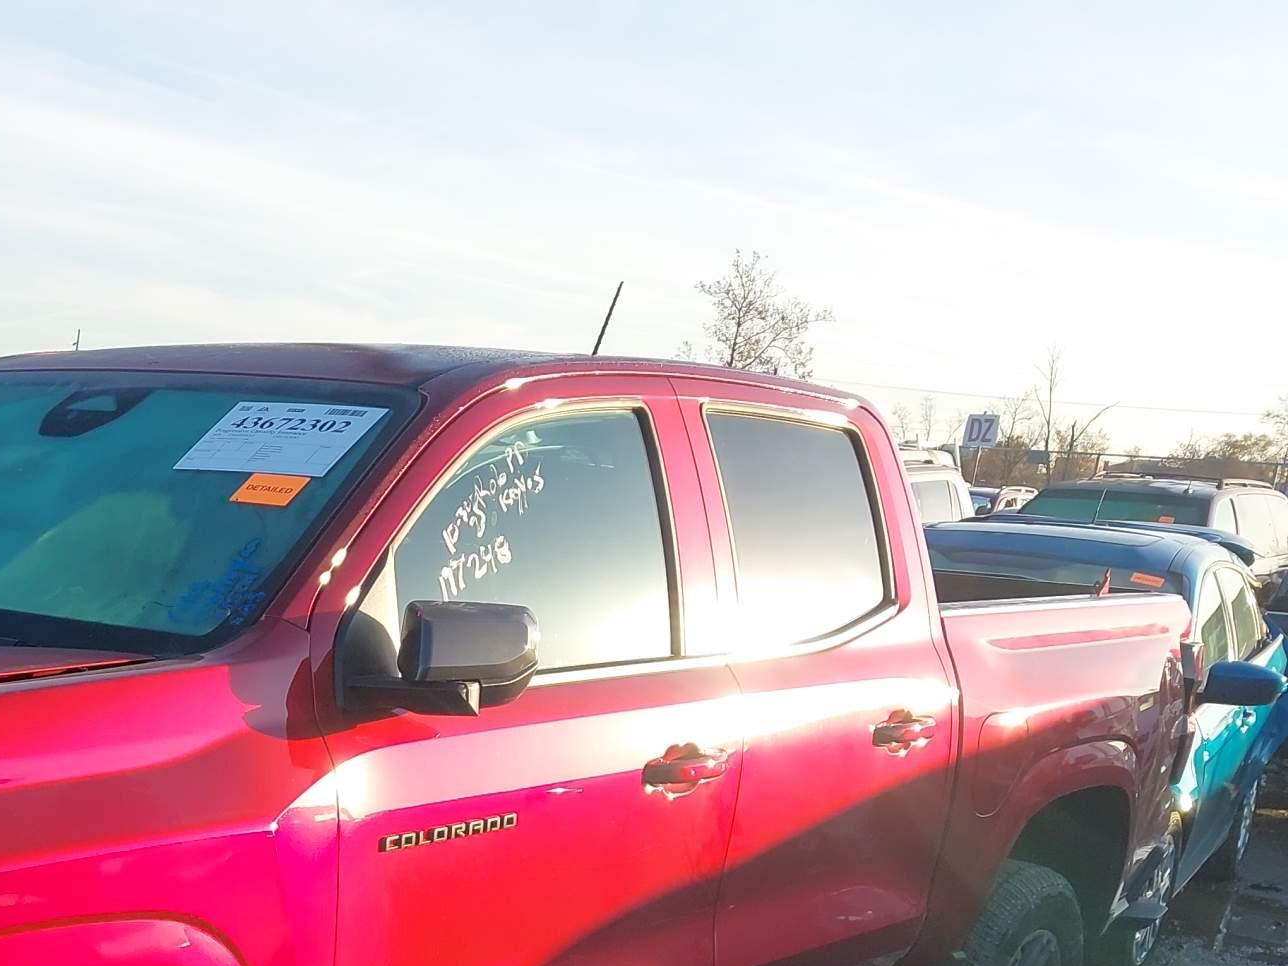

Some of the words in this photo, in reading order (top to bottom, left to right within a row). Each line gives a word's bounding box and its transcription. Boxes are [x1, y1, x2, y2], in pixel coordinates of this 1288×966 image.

[231, 416, 353, 433] 43672302
[968, 418, 995, 442] DZ
[246, 484, 294, 494] DETAILED
[380, 813, 518, 852] COLORADO
